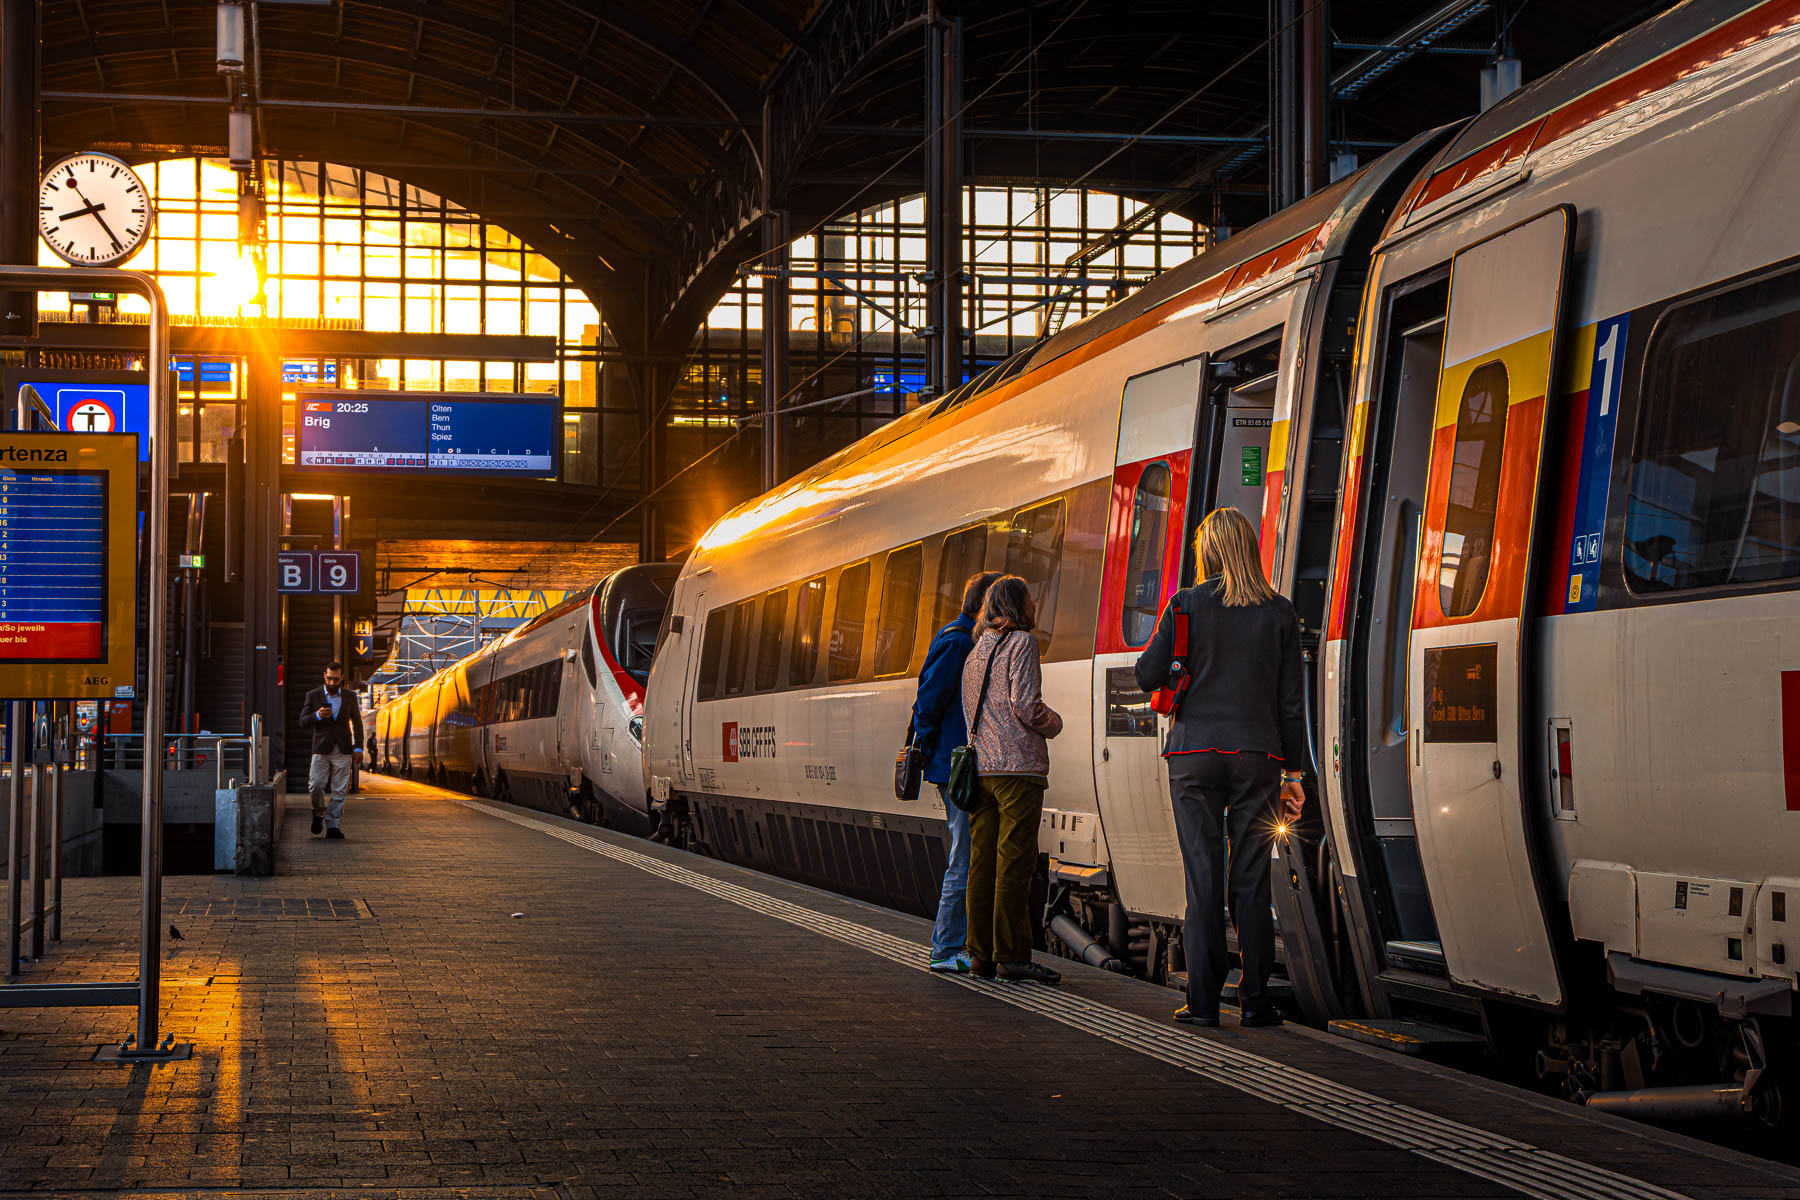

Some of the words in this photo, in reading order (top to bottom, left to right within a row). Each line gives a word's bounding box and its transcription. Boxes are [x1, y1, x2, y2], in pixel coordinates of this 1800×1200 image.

[1598, 323, 1619, 417] 1
[337, 403, 368, 413] 20:25
[432, 404, 452, 413] Olten
[304, 416, 331, 429] Brig
[432, 414, 450, 422] Bern
[431, 433, 453, 441] Spiez
[0, 446, 68, 462] rtenza
[1, 565, 7, 573] 7
[283, 564, 302, 587] B
[329, 564, 347, 587] 9
[1, 588, 6, 596] 1
[1, 611, 7, 619] 8
[17, 624, 46, 633] jeweils
[84, 677, 109, 685] AEG
[739, 727, 751, 759] SBB
[752, 726, 763, 759] CFF
[764, 725, 776, 759] FFS
